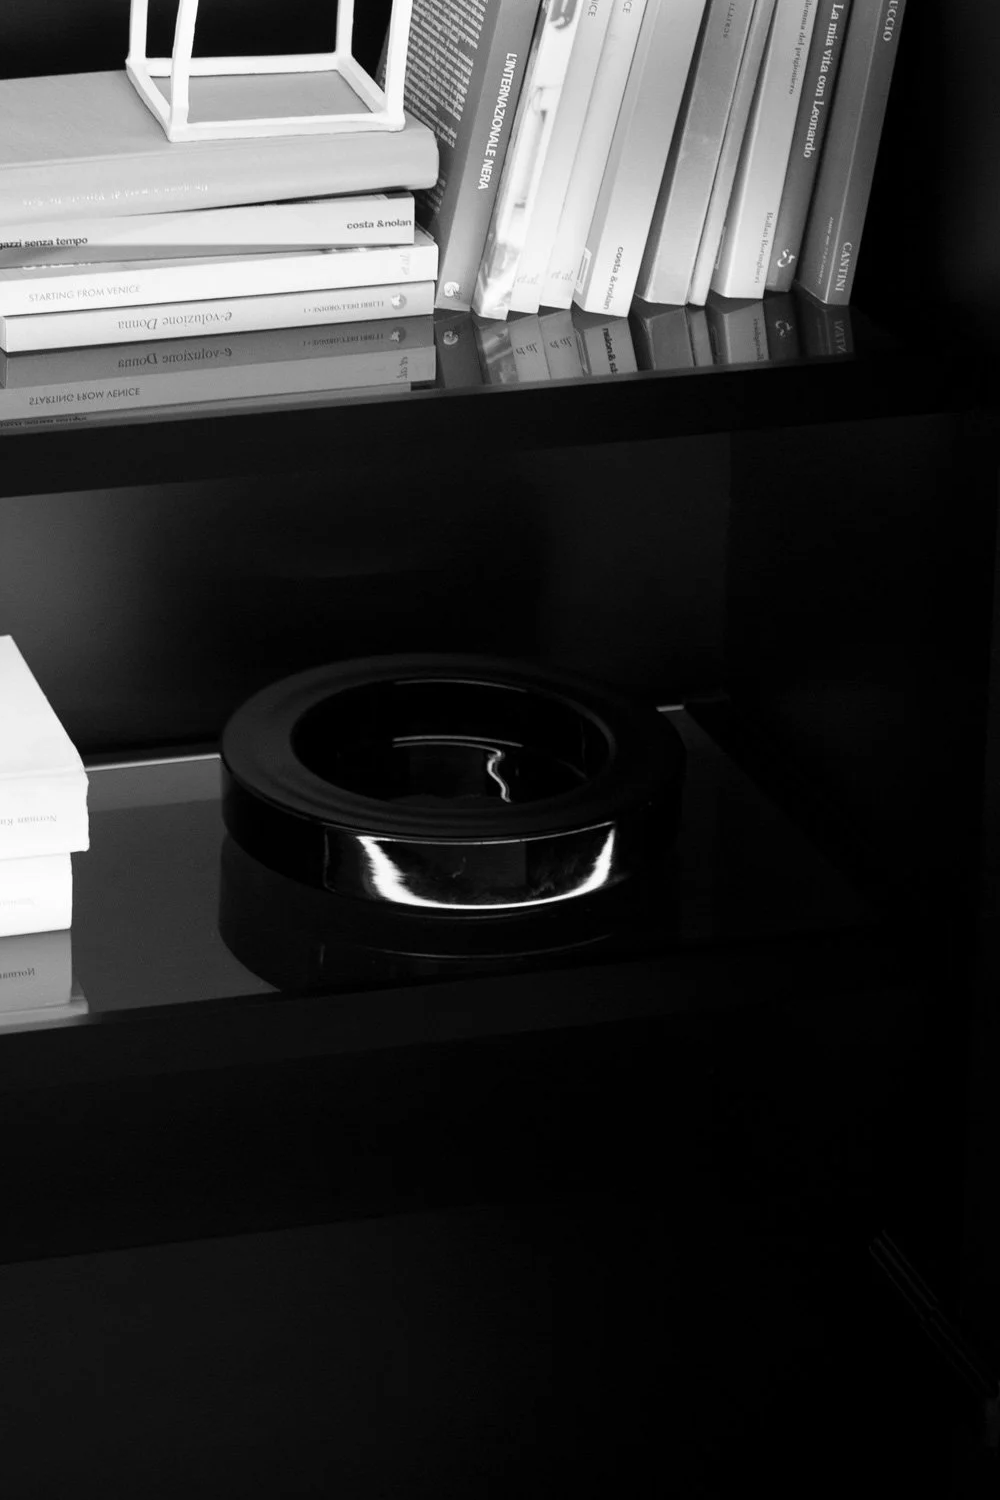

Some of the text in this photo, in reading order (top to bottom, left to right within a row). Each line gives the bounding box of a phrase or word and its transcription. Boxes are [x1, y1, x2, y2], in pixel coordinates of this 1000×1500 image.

[796, 31, 807, 45] del
[785, 45, 803, 95] prigioniero
[801, 2, 844, 160] La mia vita con Leonardo
[476, 52, 517, 191] L'INTERNAZIONALE NERA
[345, 219, 374, 230] costa
[761, 211, 774, 238] Bollati
[24, 238, 52, 247] senza
[55, 236, 88, 247] tempo
[611, 245, 625, 274] costa
[834, 240, 852, 292] CANTINI
[27, 284, 141, 303] STARTING FROM VENICE
[117, 310, 232, 332] e-voluzione Donna
